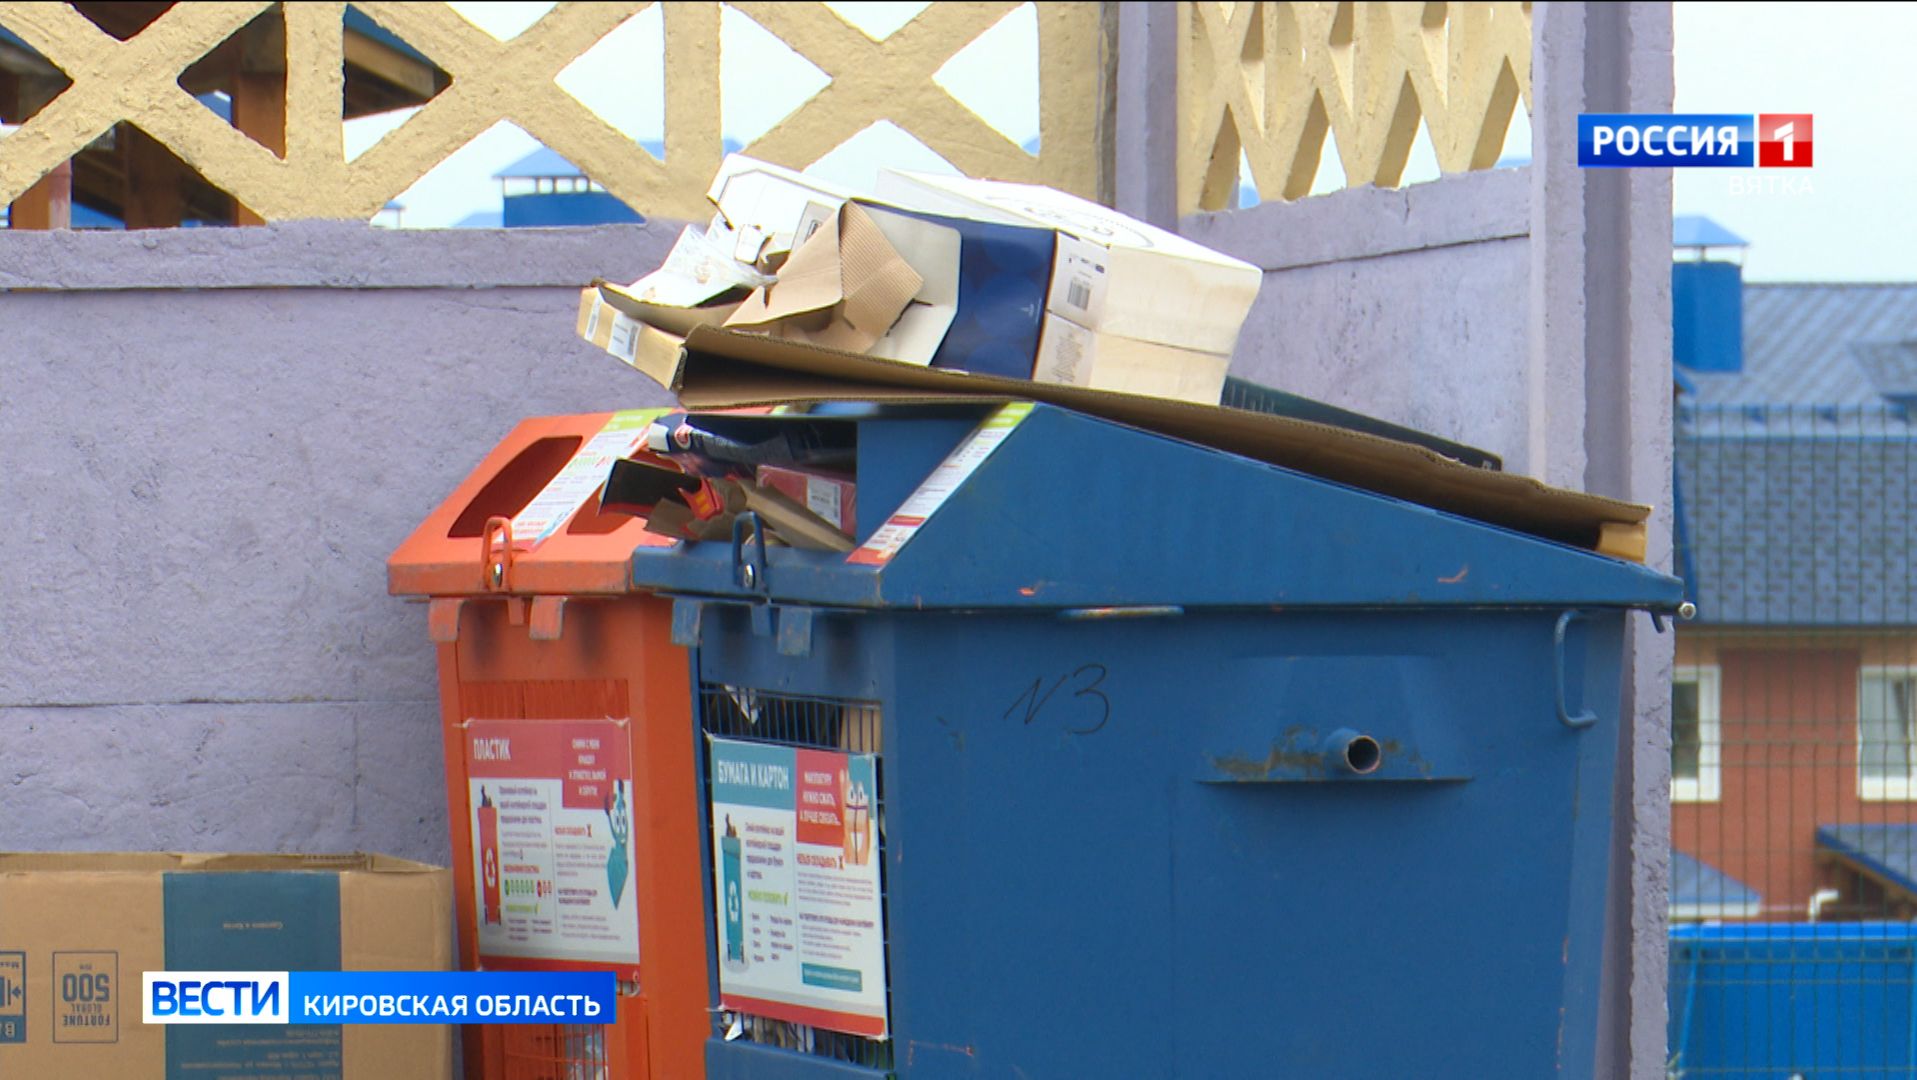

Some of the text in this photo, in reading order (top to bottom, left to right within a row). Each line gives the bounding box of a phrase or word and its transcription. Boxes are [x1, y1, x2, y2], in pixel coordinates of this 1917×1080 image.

[473, 738, 511, 760] ПЛАСТИК
[717, 760, 749, 786] БУМАГА
[757, 764, 790, 790] КАРТОН
[62, 973, 110, 1002] 500
[62, 1015, 111, 1026] FORTUNE
